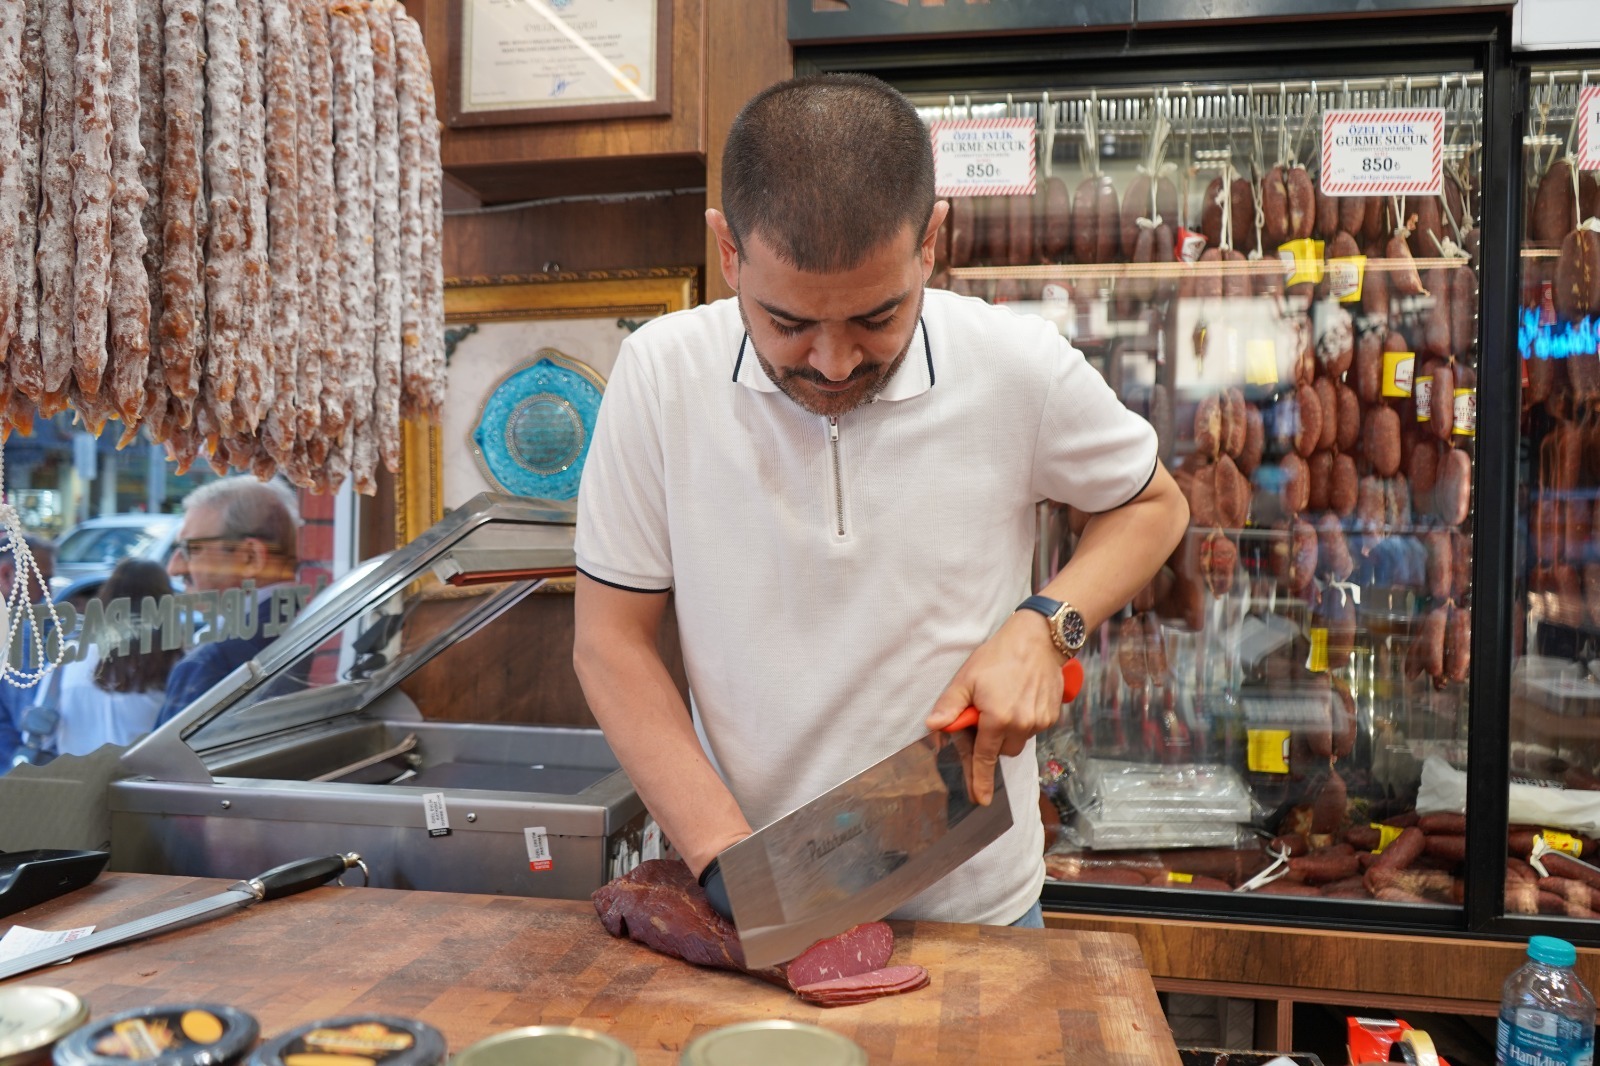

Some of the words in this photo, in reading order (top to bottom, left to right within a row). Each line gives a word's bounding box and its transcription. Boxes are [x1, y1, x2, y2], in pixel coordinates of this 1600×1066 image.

[1348, 124, 1376, 135] ÖZEL
[1381, 123, 1415, 134] EVLİK
[953, 131, 977, 140] ÖZEL
[982, 130, 1013, 140] EVLİK
[1335, 135, 1382, 146] GURME
[1385, 134, 1428, 146] SUCUK
[941, 142, 983, 152] GURME
[986, 141, 1025, 152] SUCUK
